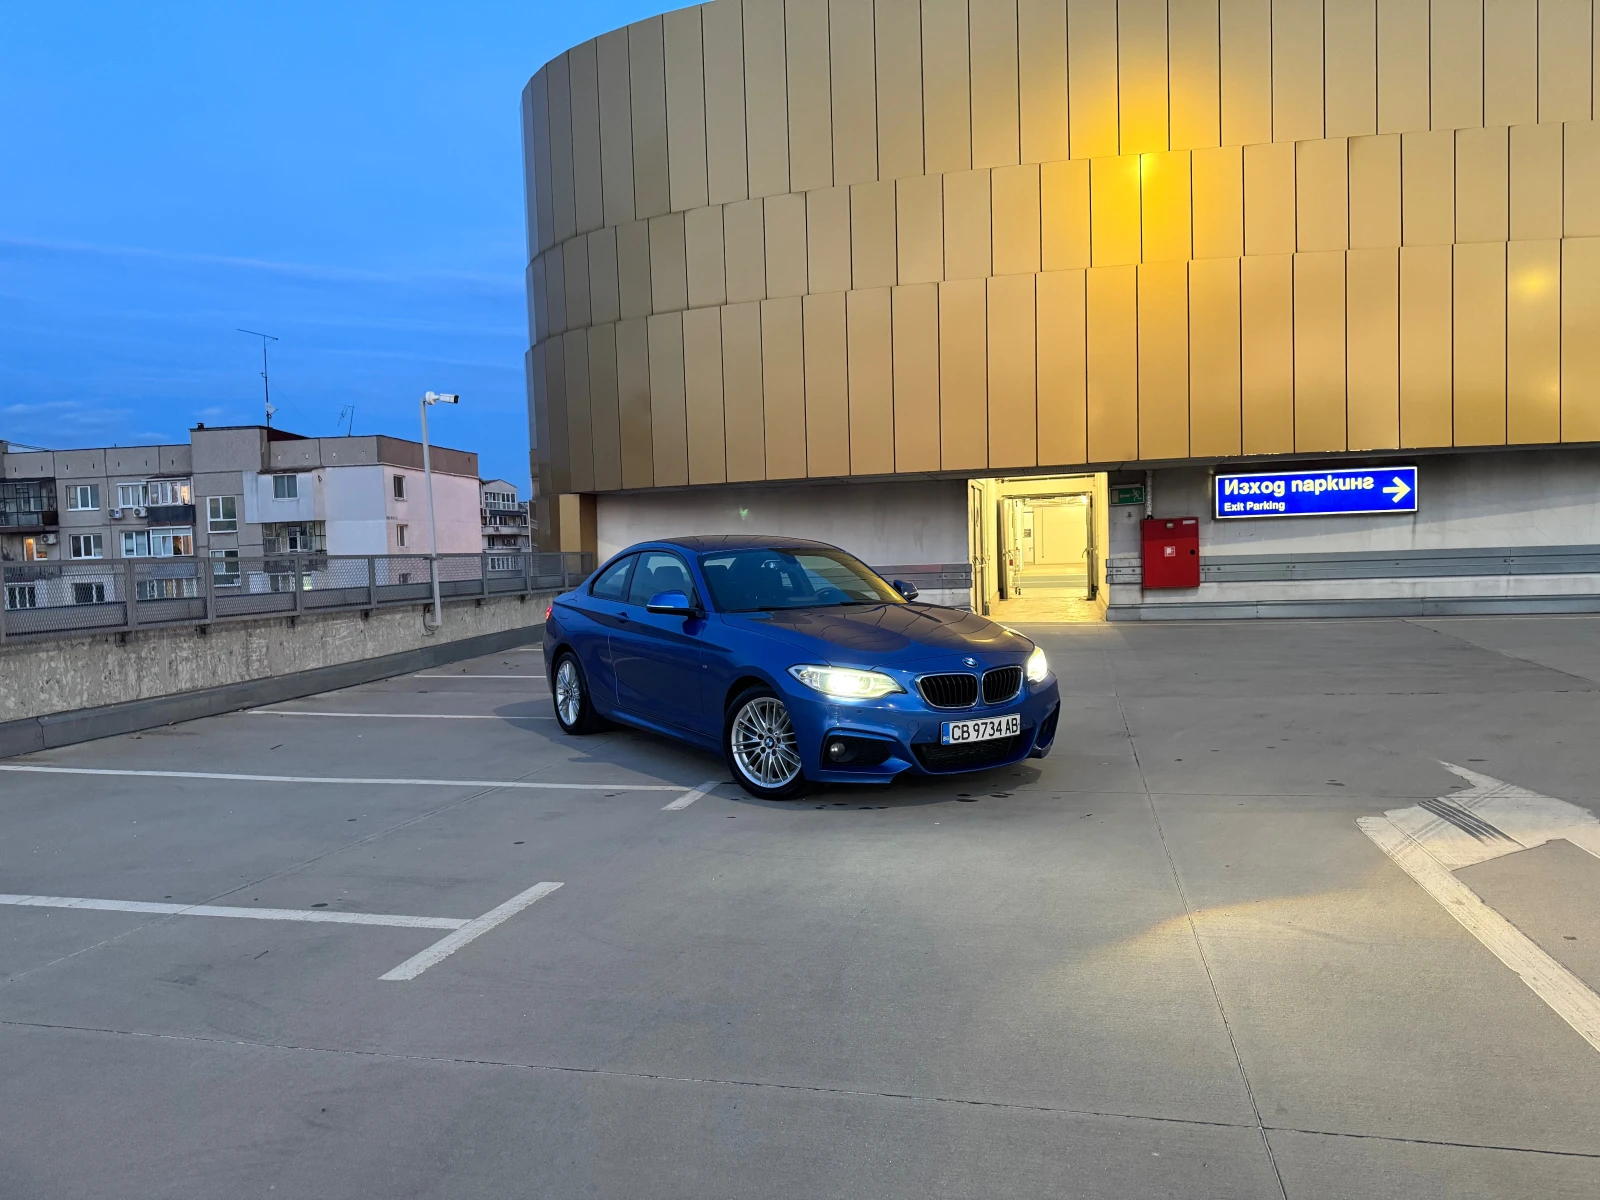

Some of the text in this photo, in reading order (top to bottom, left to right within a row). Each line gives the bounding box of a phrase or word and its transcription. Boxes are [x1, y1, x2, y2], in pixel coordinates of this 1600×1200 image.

[1224, 475, 1375, 497] Изход паркинг
[1224, 501, 1286, 511] Exit Parking
[952, 718, 1018, 741] CB 9734 AB
